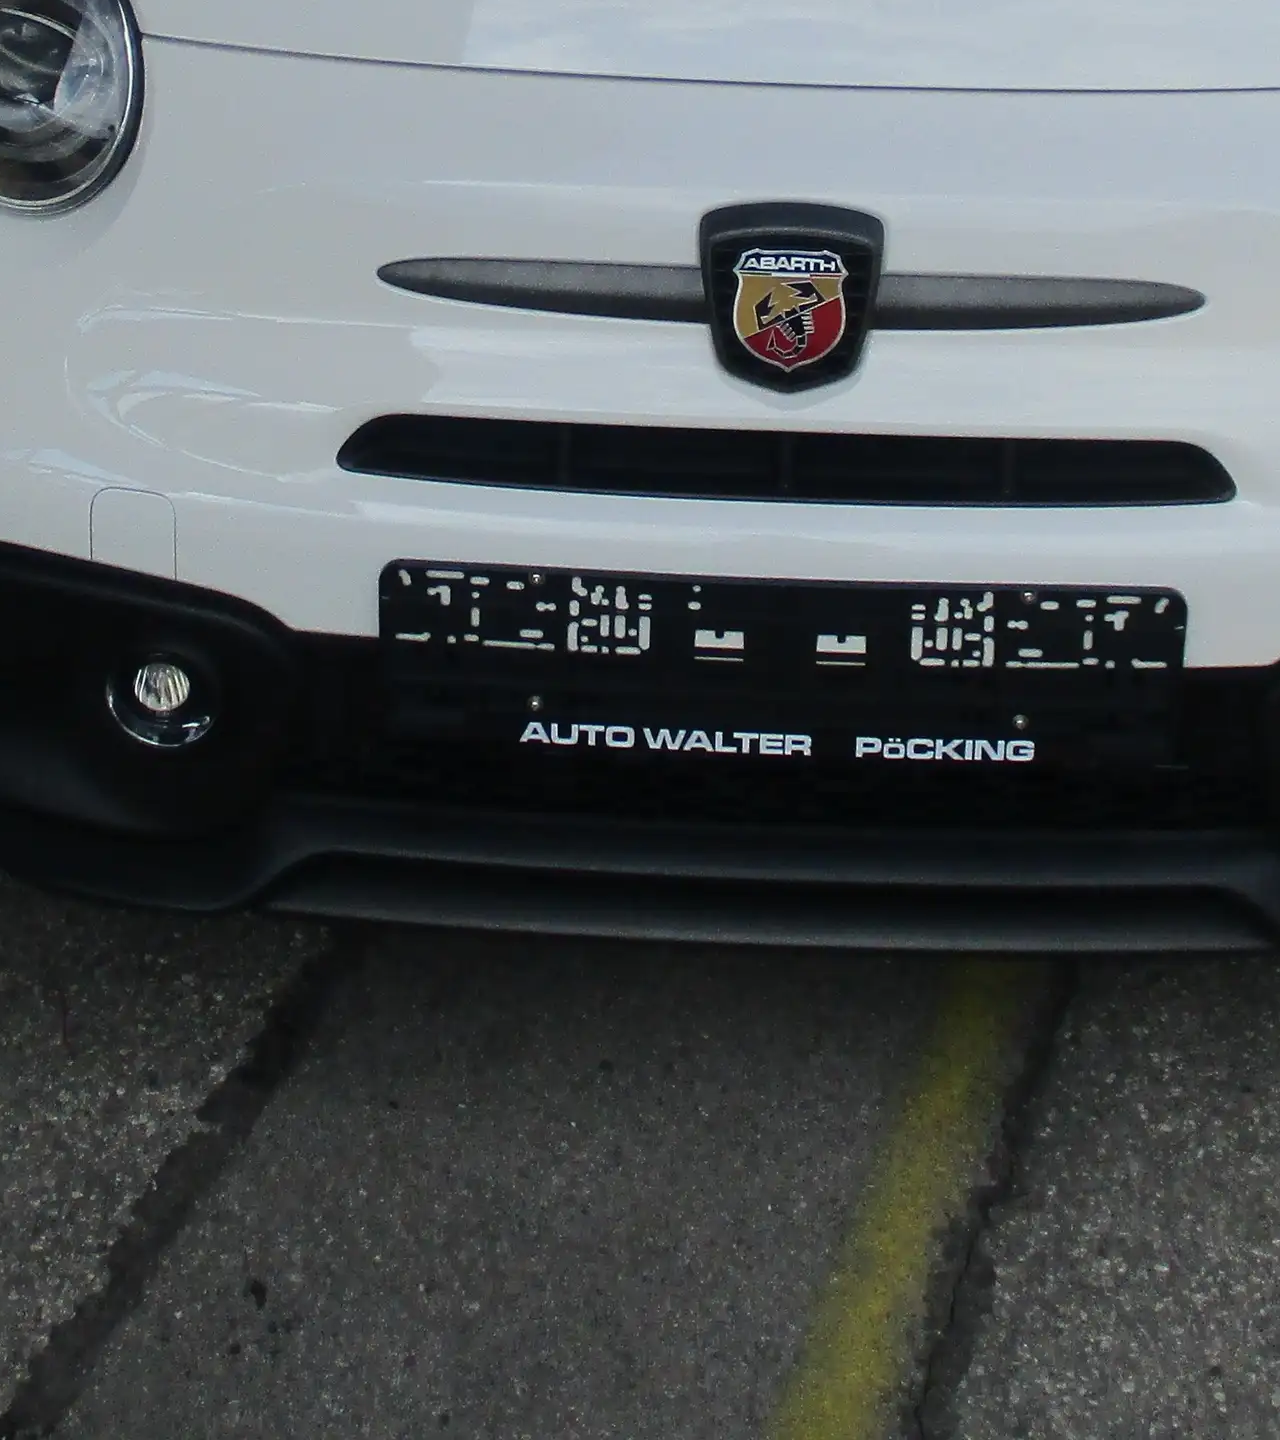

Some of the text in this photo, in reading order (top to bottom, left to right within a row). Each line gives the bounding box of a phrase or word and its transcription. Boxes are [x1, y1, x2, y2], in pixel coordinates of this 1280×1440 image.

[744, 256, 836, 272] ABARTH
[520, 722, 1035, 762] AUTO WALTER PöCKING
